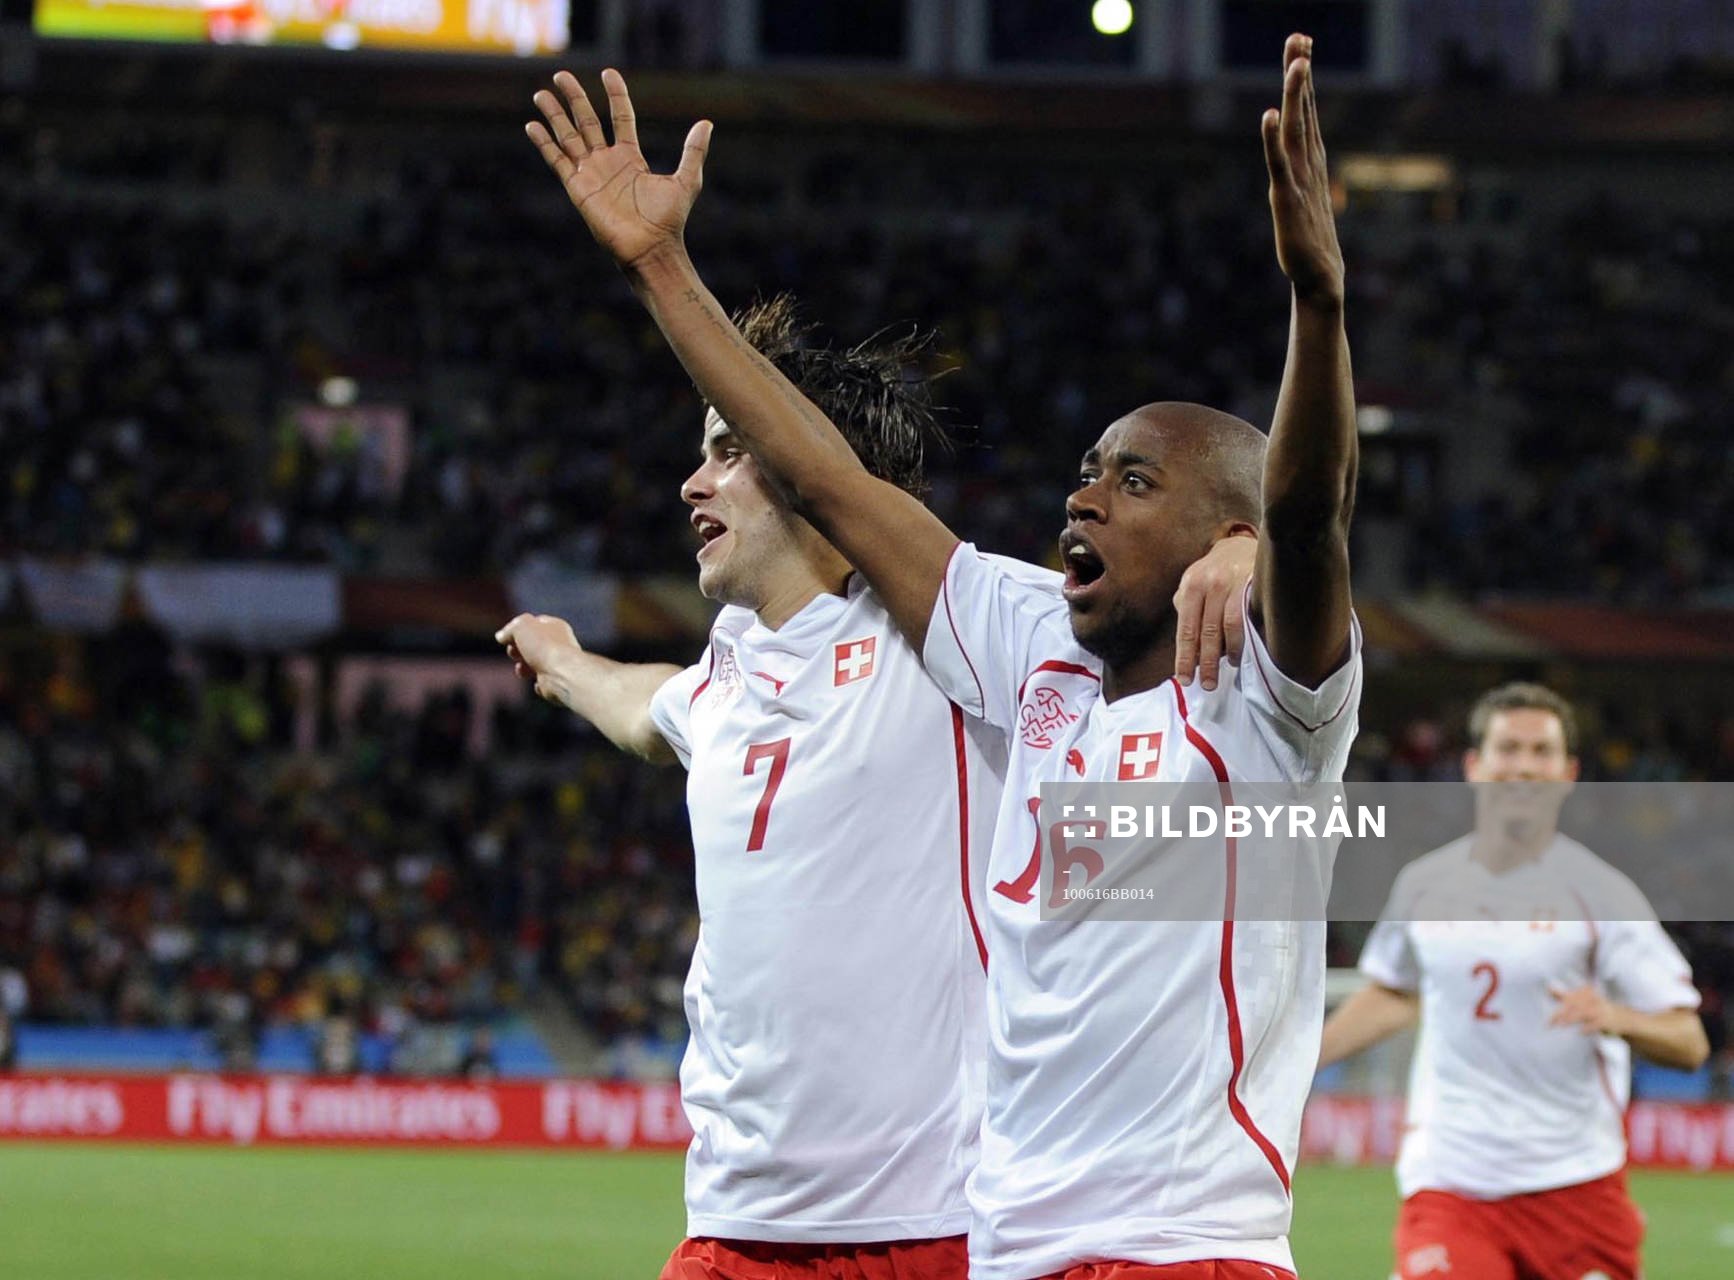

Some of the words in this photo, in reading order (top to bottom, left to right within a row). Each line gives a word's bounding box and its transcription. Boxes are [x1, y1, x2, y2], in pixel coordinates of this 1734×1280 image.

[743, 737, 792, 852] 7
[992, 796, 1108, 909] 16
[1471, 961, 1502, 1021] 2
[166, 1075, 261, 1144] Fly
[267, 1075, 500, 1138] Emirates
[543, 1080, 637, 1150] Fly
